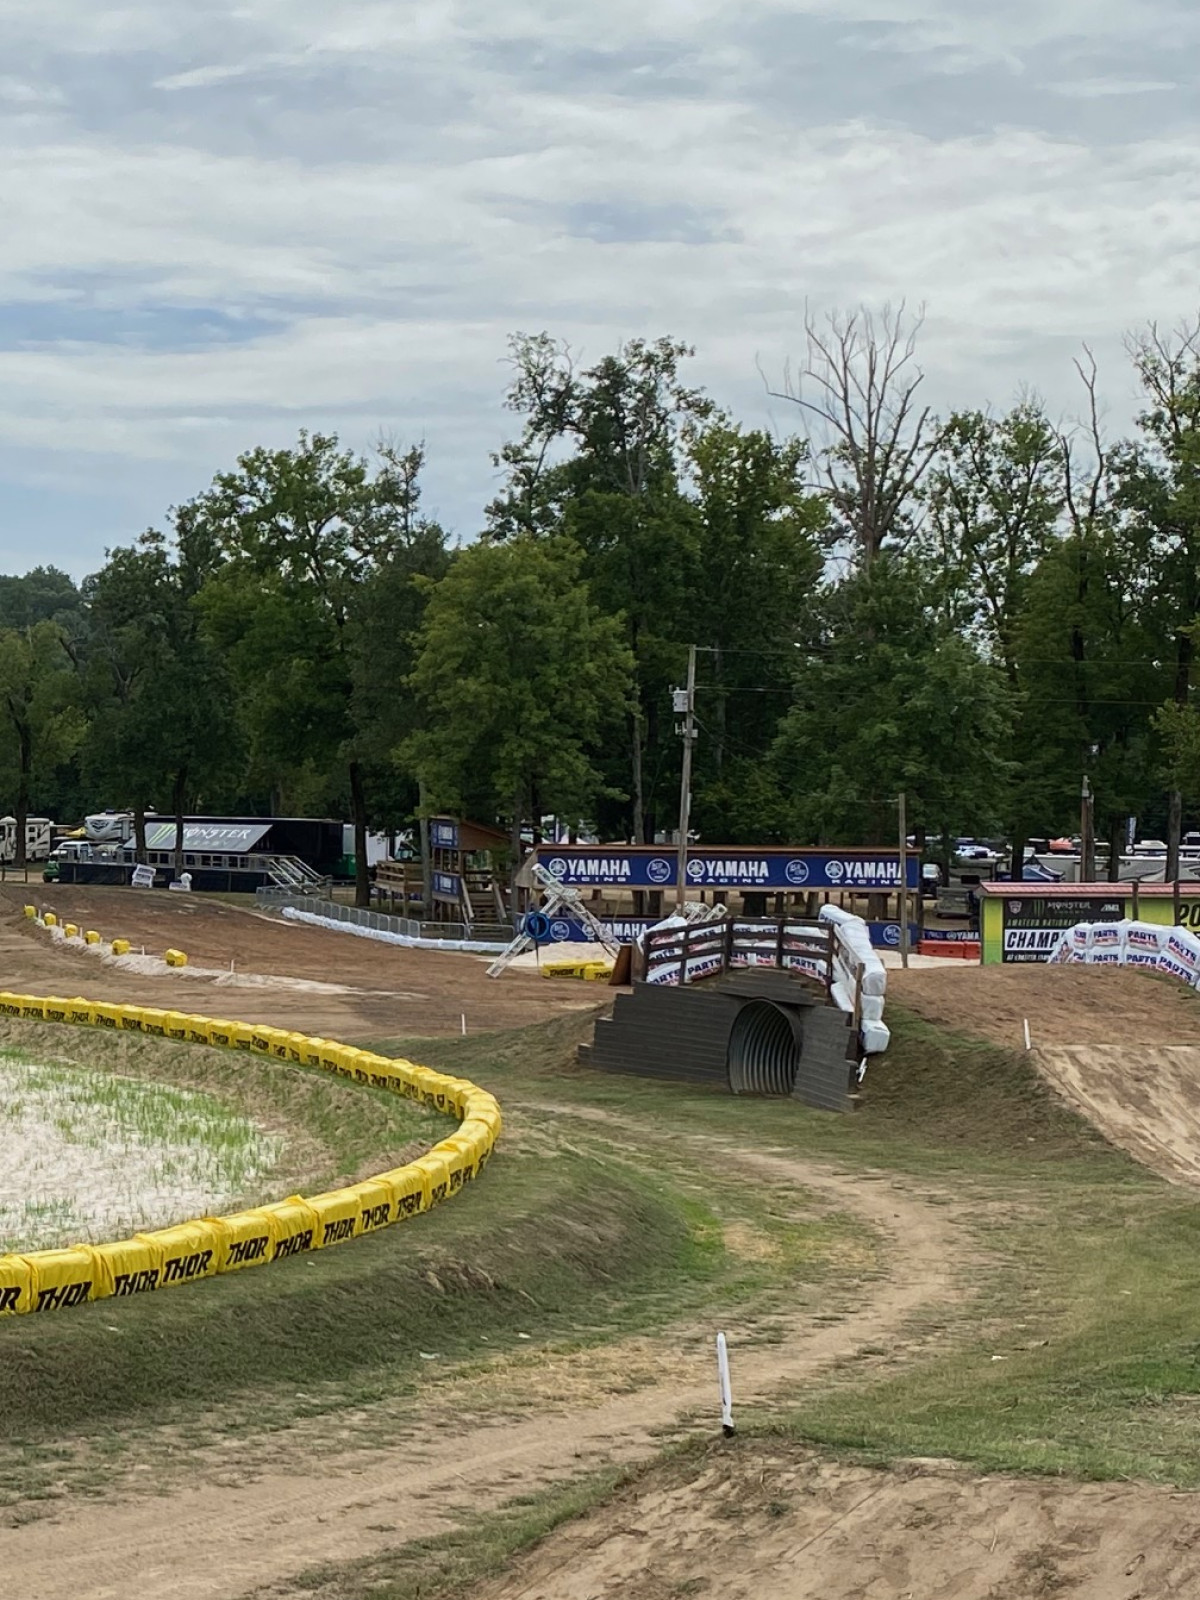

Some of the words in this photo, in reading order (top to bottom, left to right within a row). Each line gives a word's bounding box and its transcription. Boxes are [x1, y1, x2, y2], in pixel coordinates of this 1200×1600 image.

[183, 826, 251, 840] ONSTER
[567, 859, 631, 877] YAMAHA
[706, 861, 769, 878] YAMAHA
[1006, 931, 1060, 949] CHAMP
[688, 958, 722, 975] PARTS
[790, 956, 817, 971] PARTS
[1094, 954, 1118, 962] PARTS
[1127, 954, 1157, 965] PARTS
[1160, 956, 1193, 981] PARTS
[363, 1203, 390, 1229] THOR
[323, 1217, 356, 1245] THOR
[226, 1236, 269, 1265] THOR
[274, 1230, 313, 1260] THOR
[163, 1250, 213, 1283] THOR
[113, 1269, 159, 1296] THOR
